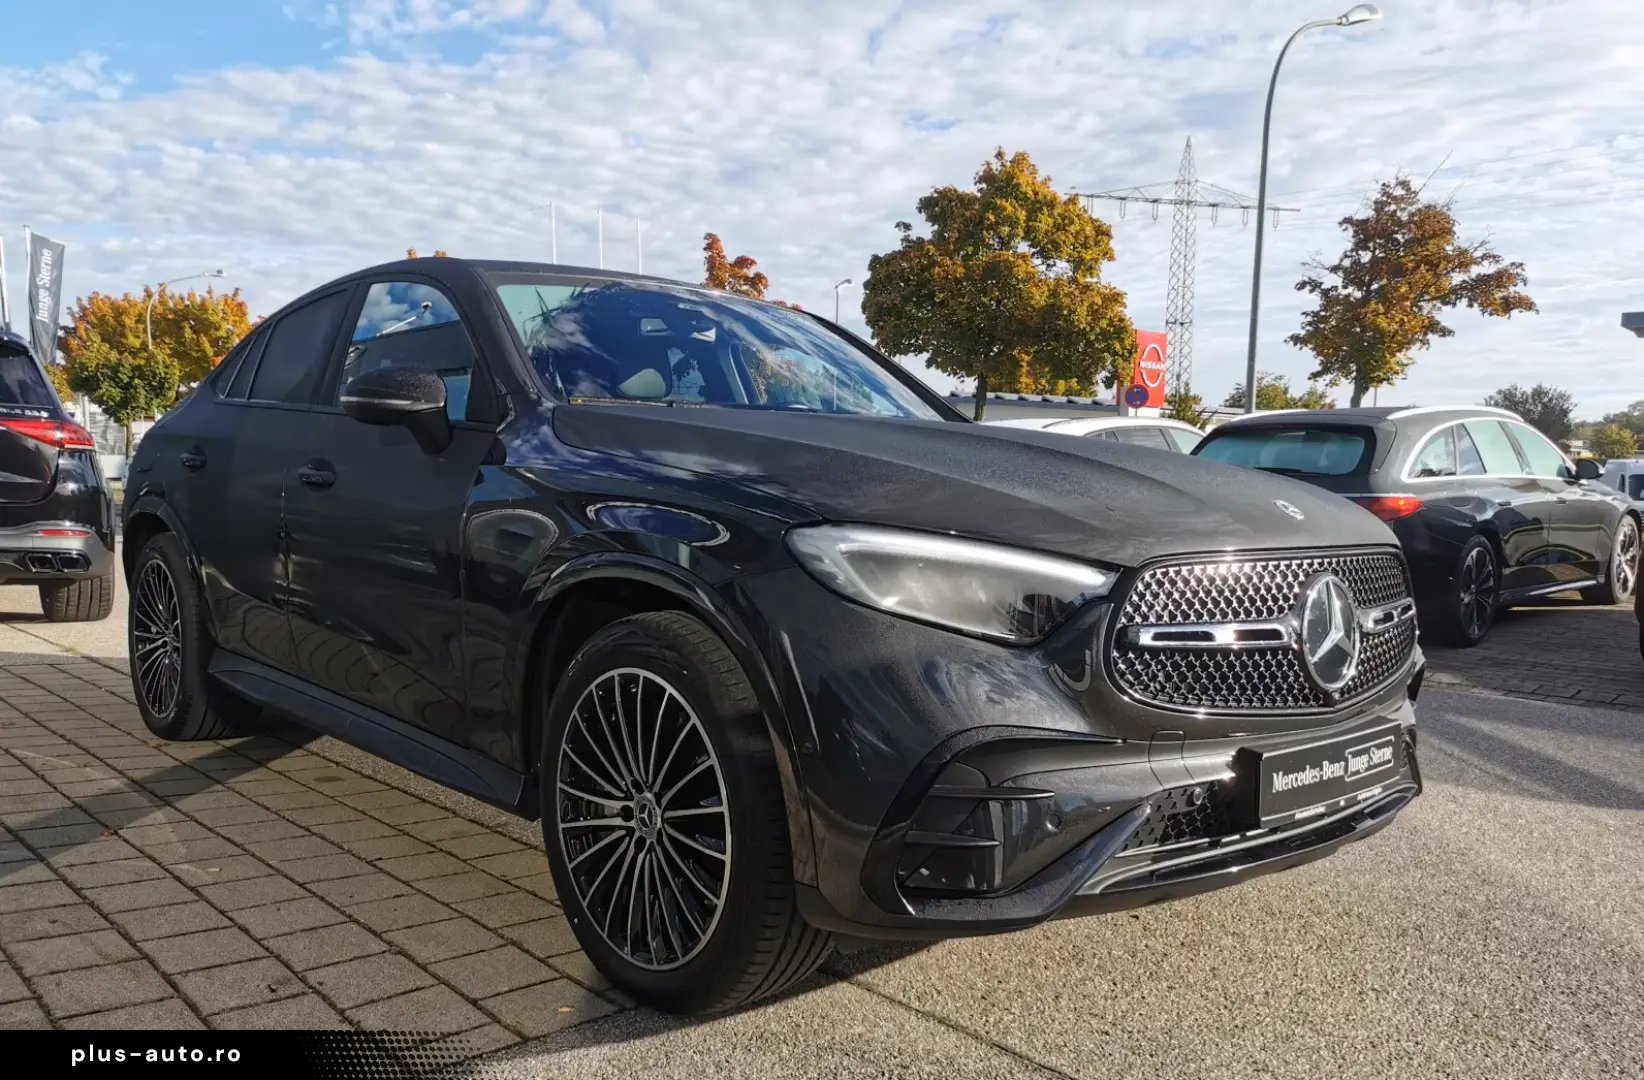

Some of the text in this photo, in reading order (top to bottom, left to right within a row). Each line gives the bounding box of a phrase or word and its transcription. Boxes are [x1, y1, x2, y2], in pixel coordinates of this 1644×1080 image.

[36, 248, 53, 323] Junge Sterne
[1139, 360, 1166, 371] NISSAN
[1272, 745, 1393, 793] Mercedes-Benz Junge Sterne
